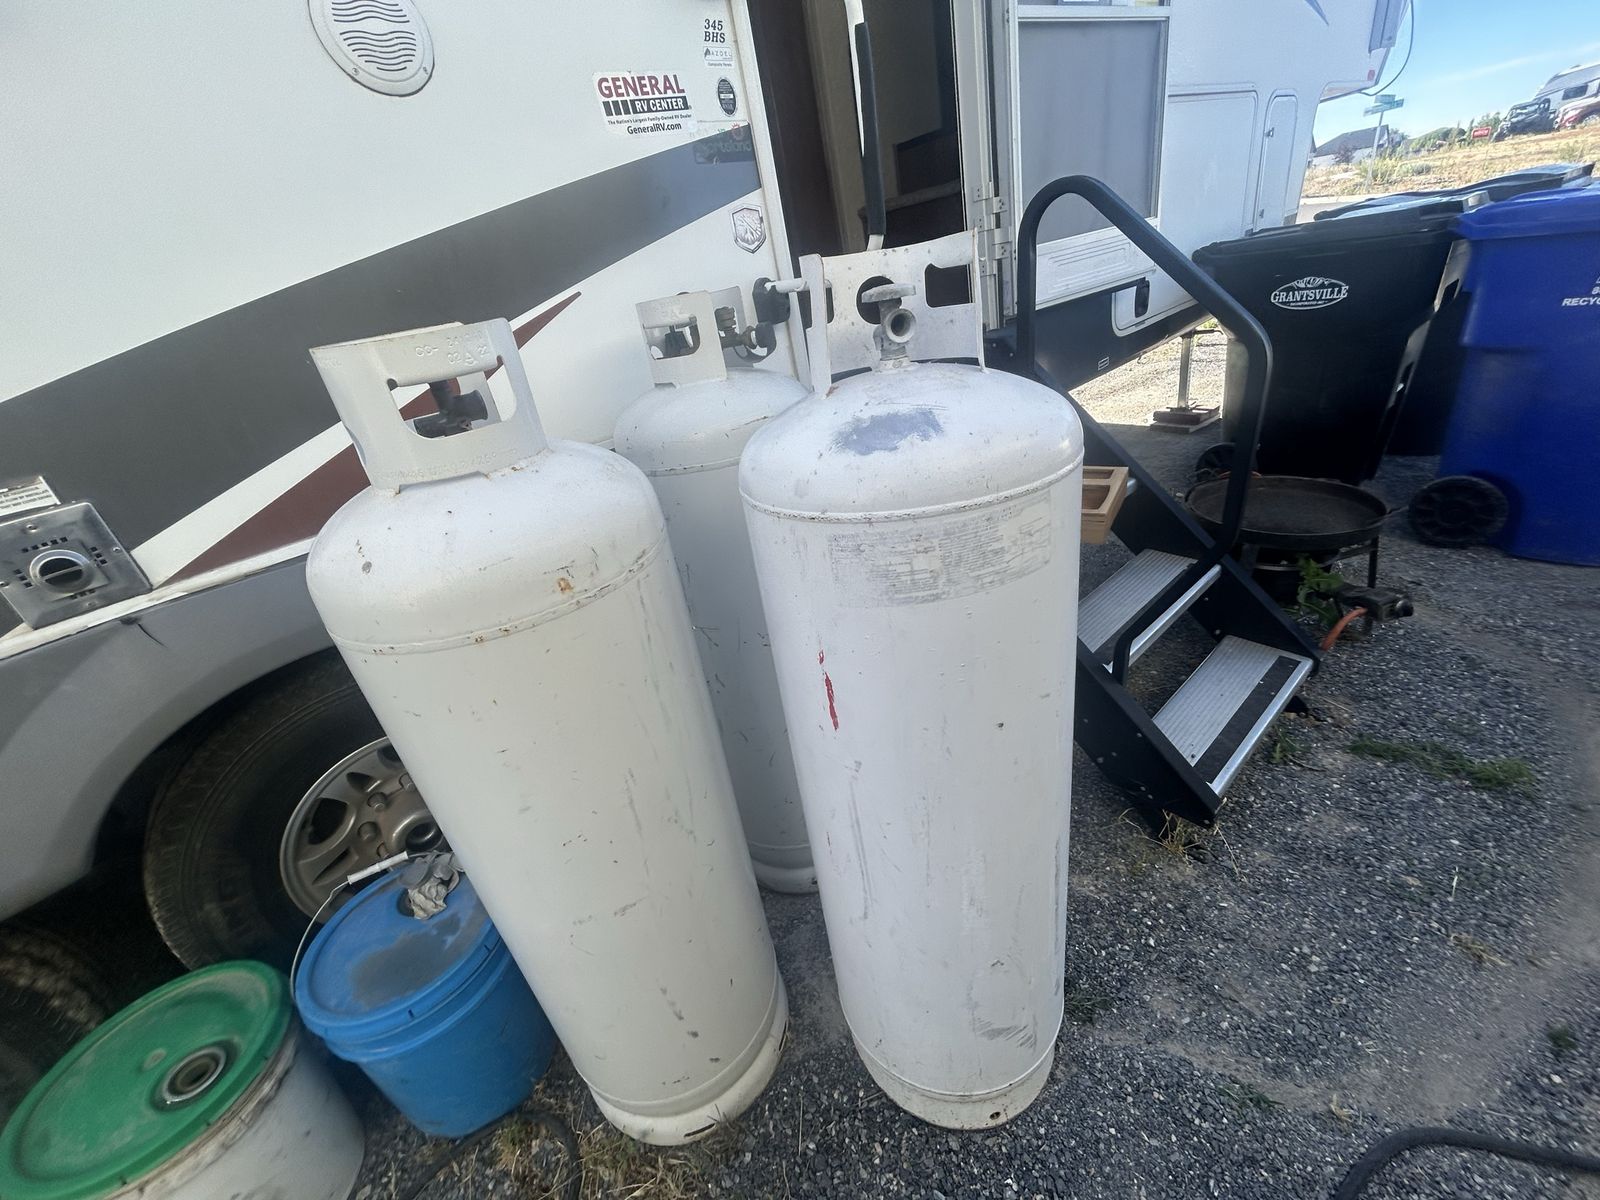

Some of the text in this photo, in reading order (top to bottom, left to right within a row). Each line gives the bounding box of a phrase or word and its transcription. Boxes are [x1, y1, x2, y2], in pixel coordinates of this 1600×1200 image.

[704, 18, 723, 31] 345
[704, 30, 726, 43] BHS
[597, 74, 685, 98] GENERAL
[634, 98, 684, 112] RV CENTER
[627, 123, 682, 135] GeneralRV.com
[1271, 286, 1349, 303] GRANTSVILLE
